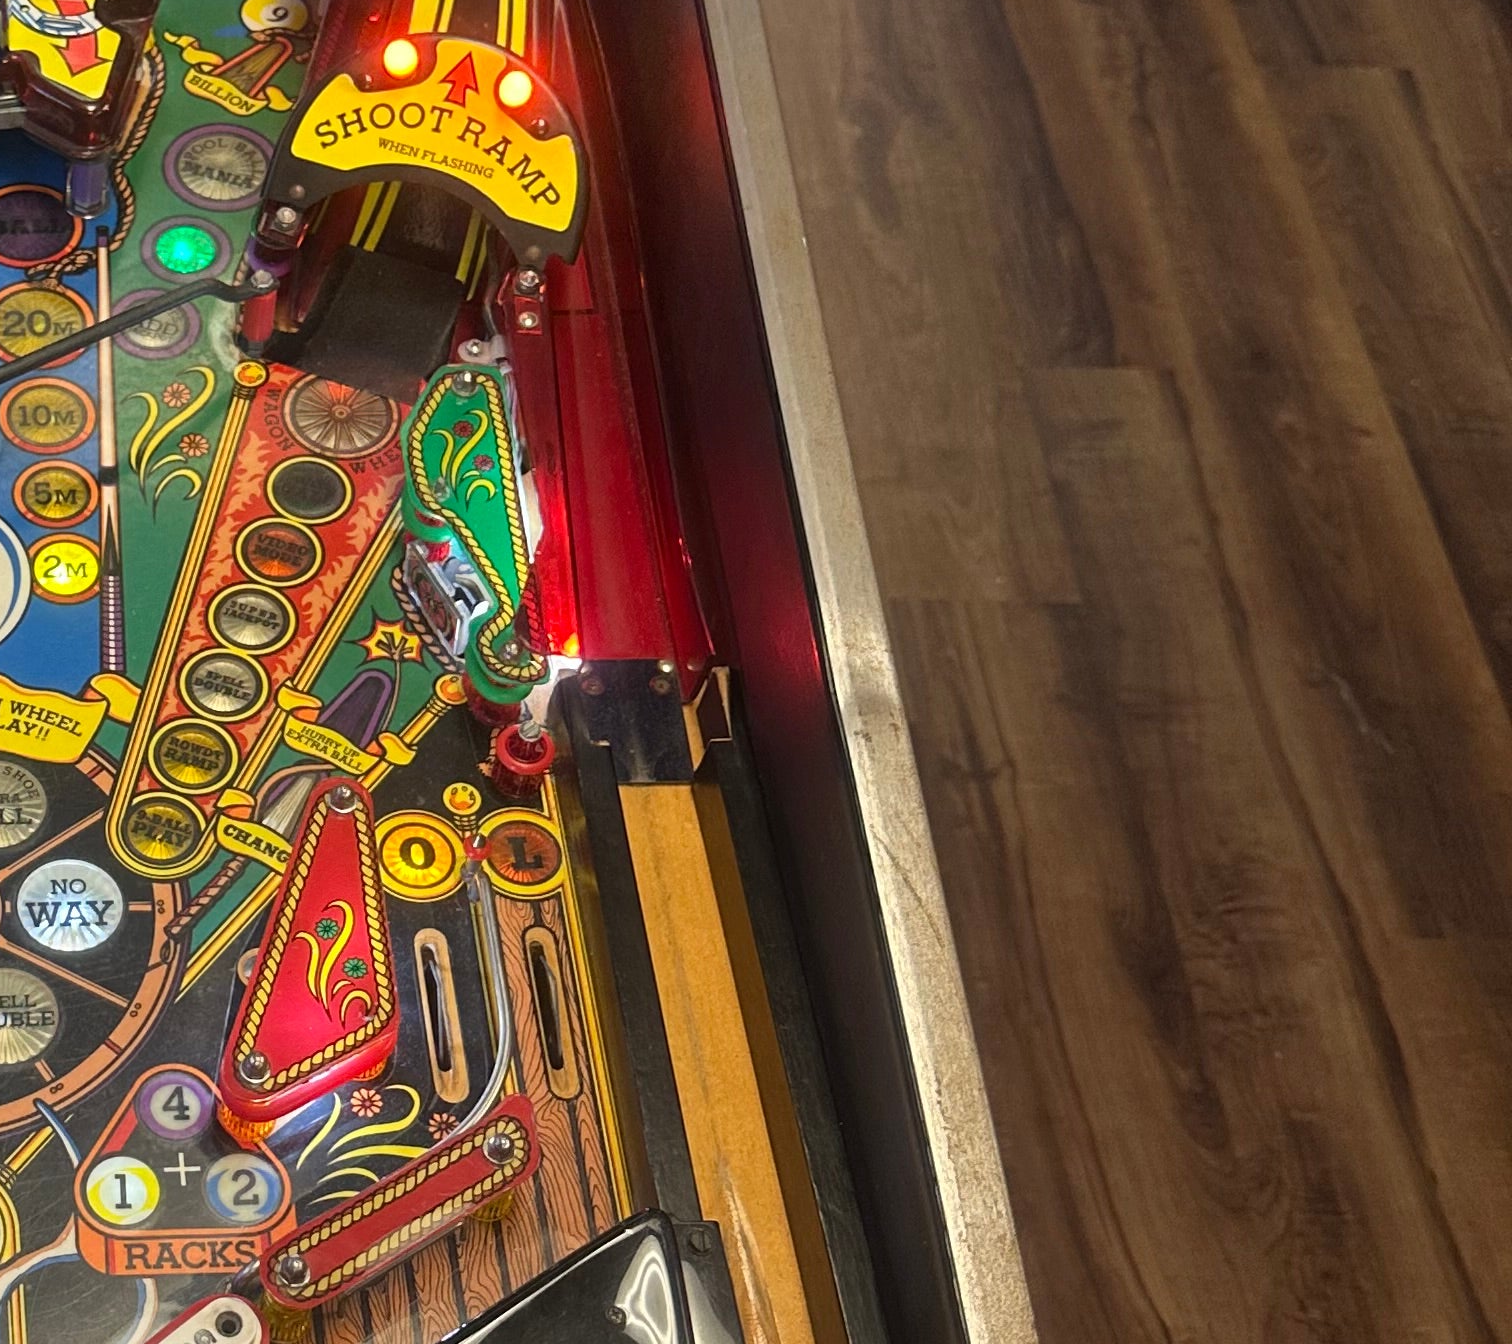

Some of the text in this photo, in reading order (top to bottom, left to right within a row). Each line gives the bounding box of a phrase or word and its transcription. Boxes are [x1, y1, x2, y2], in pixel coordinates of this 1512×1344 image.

[272, 7, 287, 22] 9
[187, 75, 256, 112] BILLION
[315, 103, 560, 208] SHOOT RAMP
[378, 138, 495, 180] WHEN FLASHING
[12, 701, 83, 737] WHEEL
[286, 730, 363, 772] EXTRA BALL
[300, 725, 339, 750] HURRY
[1, 766, 41, 799] SHOE
[51, 878, 87, 894] NO
[27, 900, 113, 928] WAY
[163, 1087, 190, 1120] 4
[113, 1175, 130, 1208] 1
[233, 1170, 258, 1205] 2
[124, 1240, 258, 1272] RACKS
